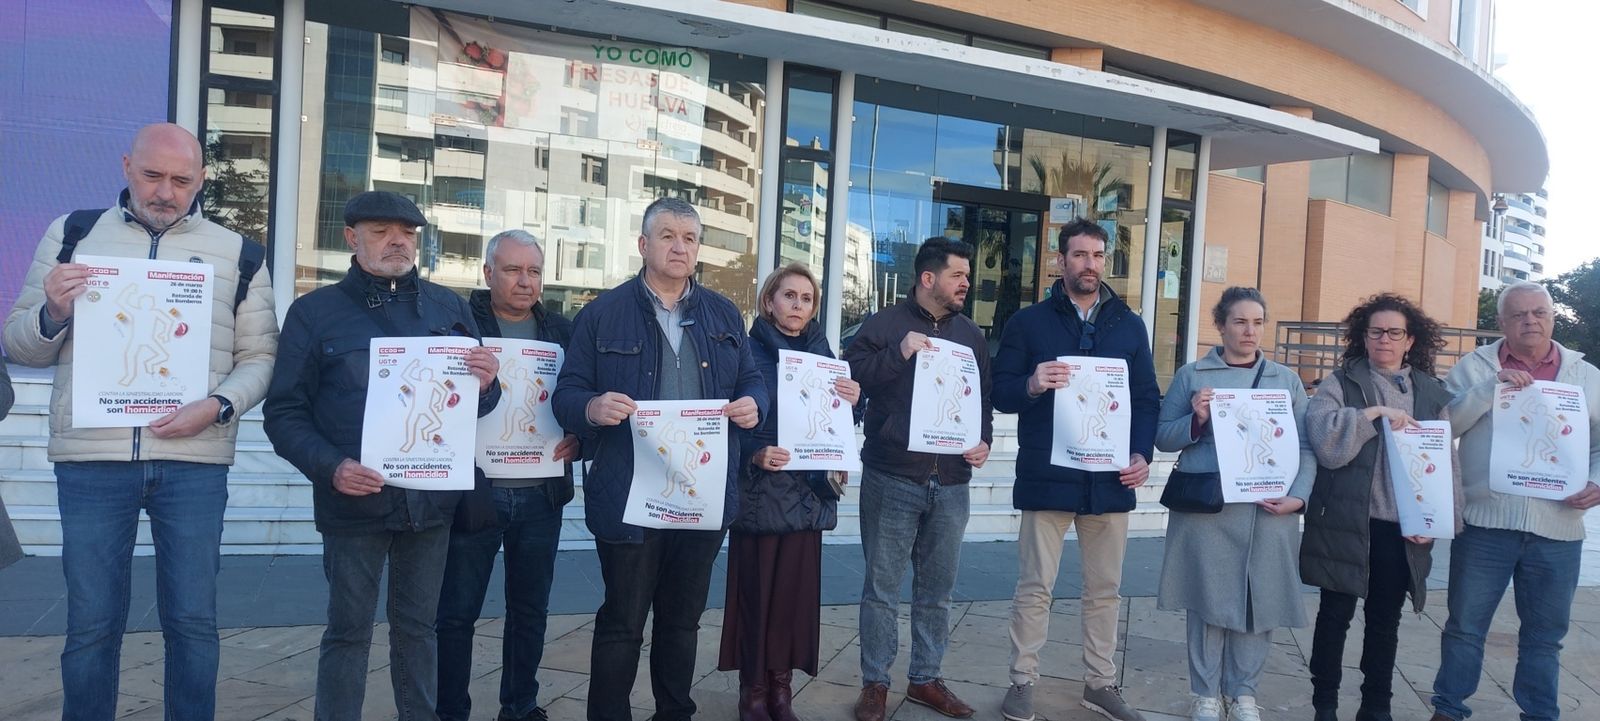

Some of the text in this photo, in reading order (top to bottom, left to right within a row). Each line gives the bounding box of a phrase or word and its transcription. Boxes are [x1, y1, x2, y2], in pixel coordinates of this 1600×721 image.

[592, 44, 692, 68] YO COMO
[569, 62, 659, 88] FRESAS
[609, 93, 687, 115] HUELVA
[150, 271, 204, 281] Manifestación
[411, 463, 453, 471] accidentes,
[645, 502, 704, 518] No son accidentes,
[662, 514, 699, 523] homicidios
